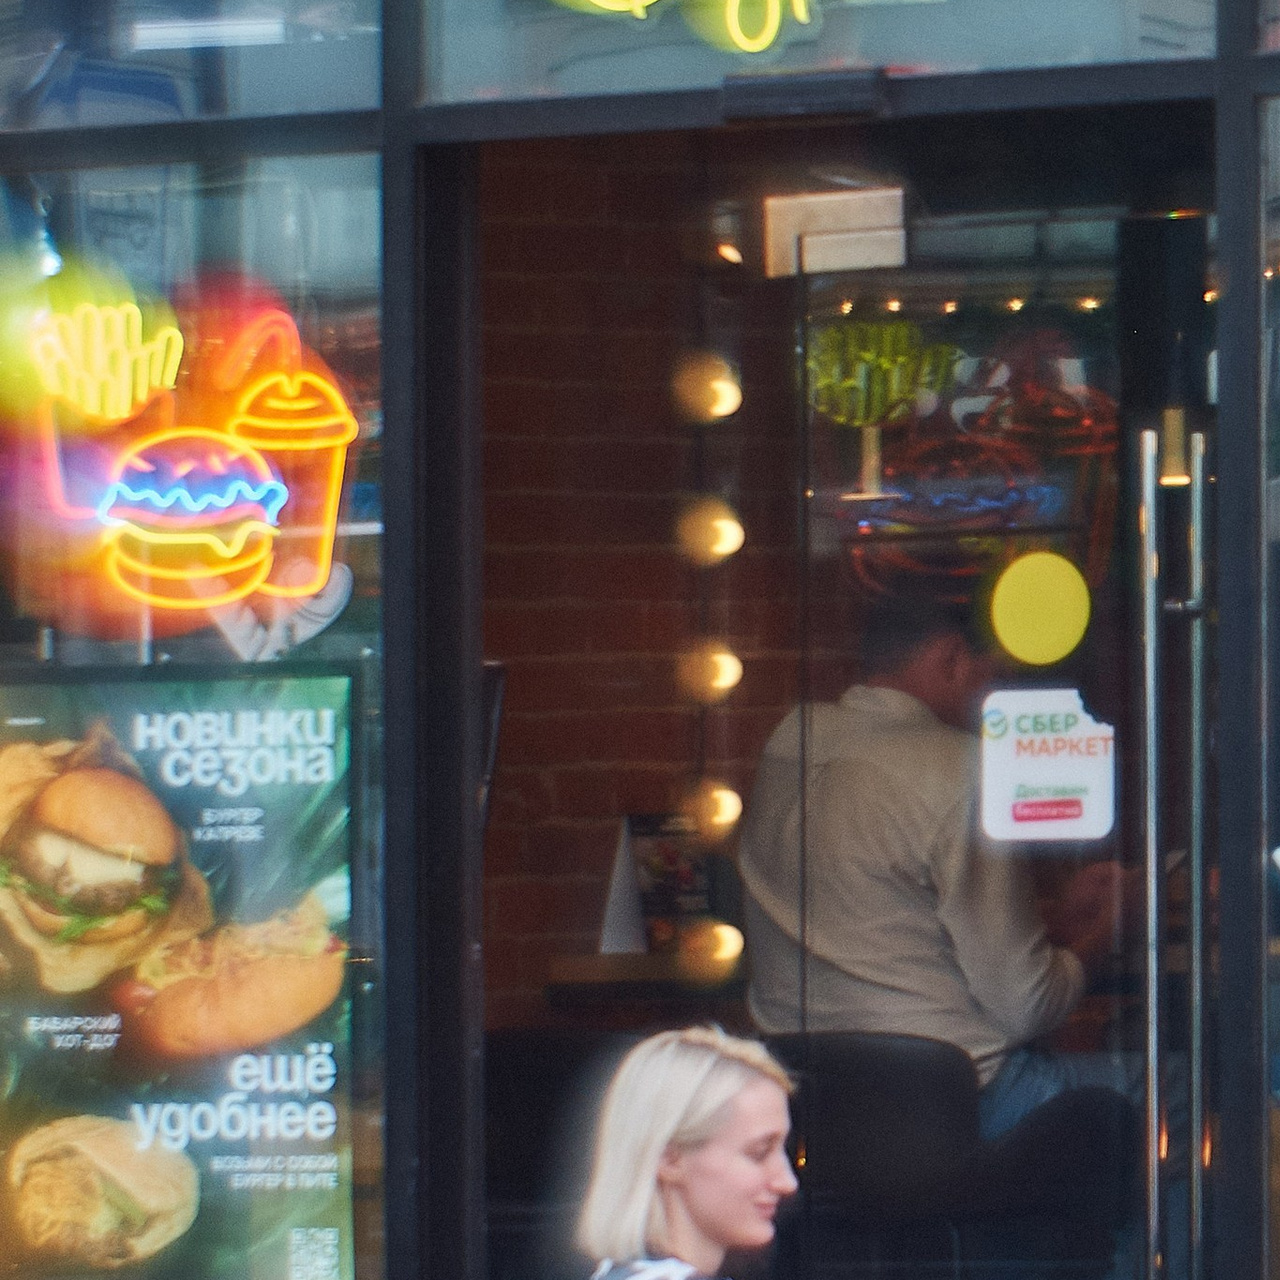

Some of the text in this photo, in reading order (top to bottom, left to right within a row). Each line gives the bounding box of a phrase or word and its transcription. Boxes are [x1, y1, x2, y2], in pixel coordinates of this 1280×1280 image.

[1014, 712, 1079, 734] СБЕР
[1014, 734, 1113, 758] МАРКЕТ
[230, 1042, 337, 1098] ещё
[131, 1092, 337, 1151] удобнее
